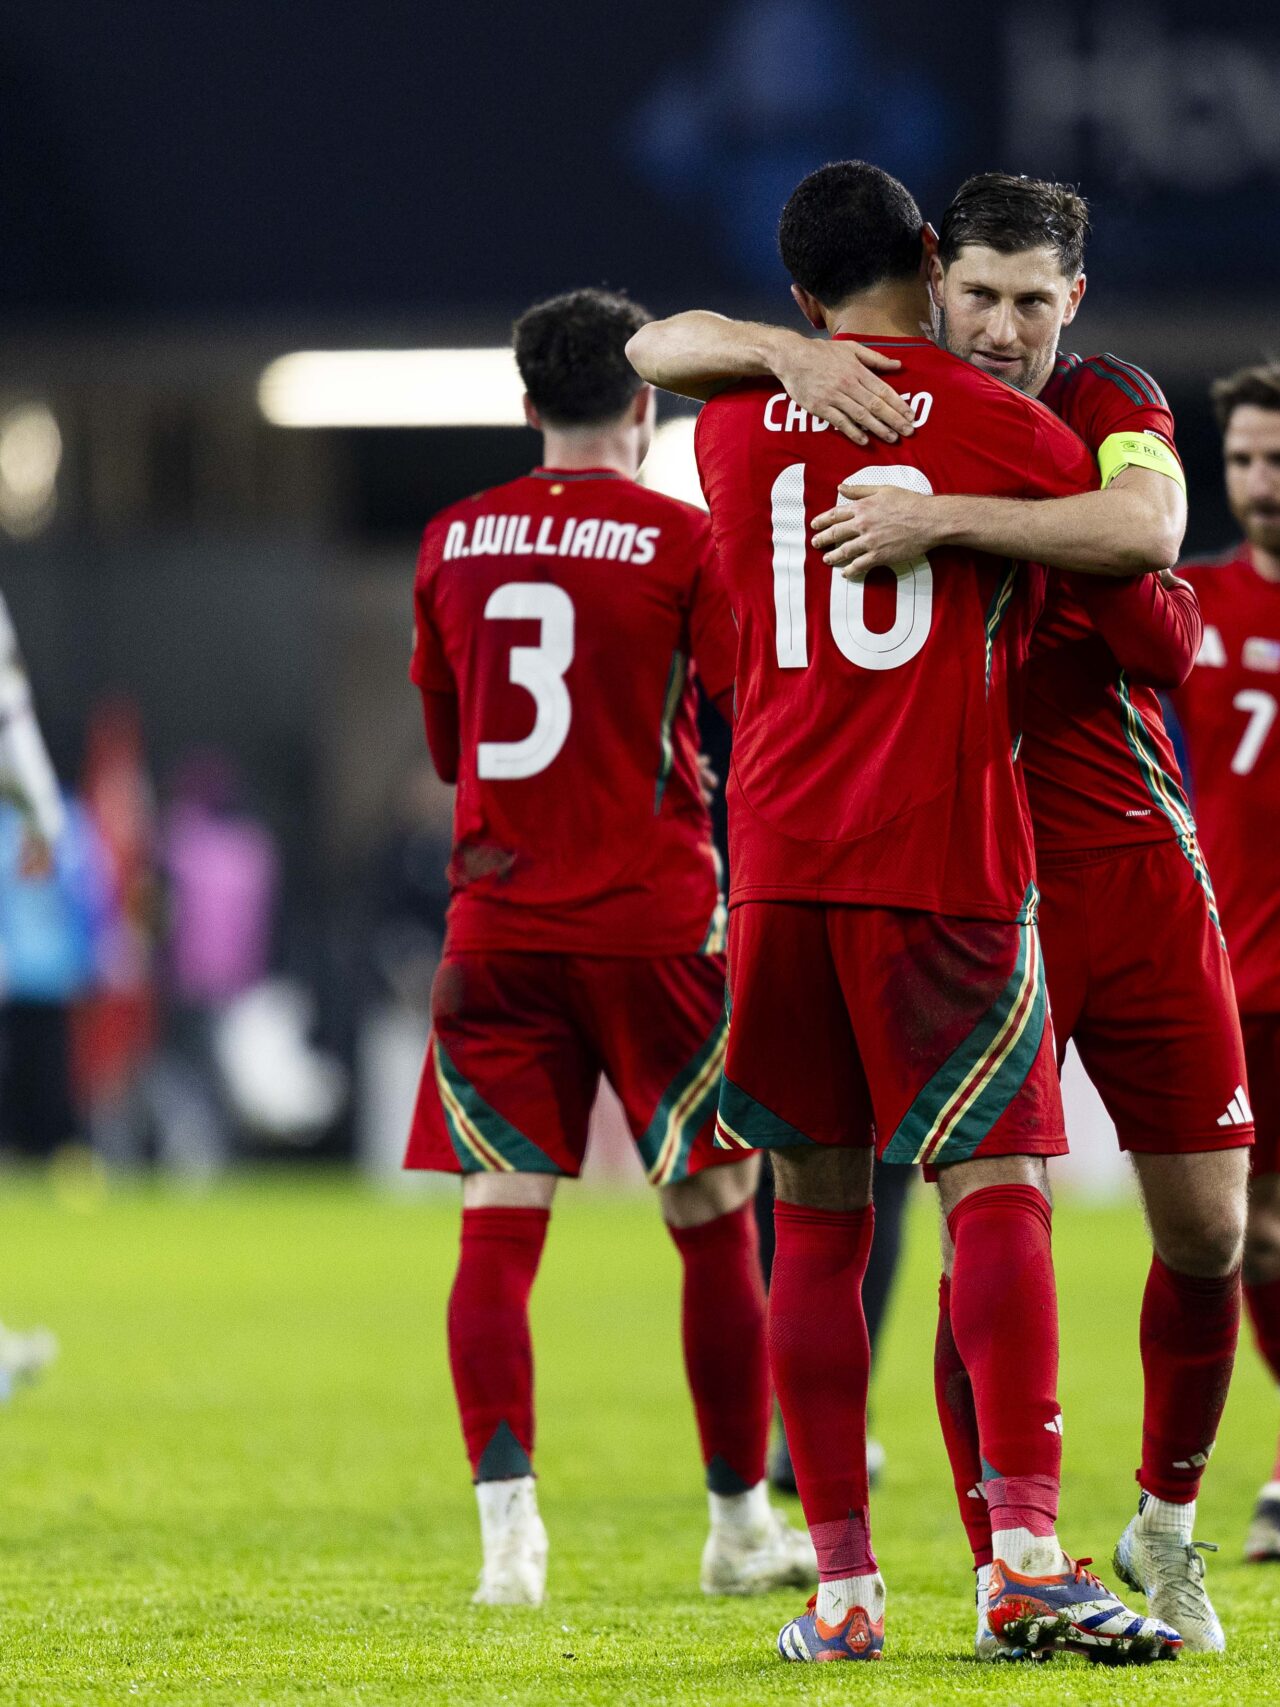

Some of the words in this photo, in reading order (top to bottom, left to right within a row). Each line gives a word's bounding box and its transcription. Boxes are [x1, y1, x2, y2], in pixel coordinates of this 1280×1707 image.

[443, 515, 660, 565] N.WILLIAMS
[477, 582, 575, 780] 3
[1231, 690, 1278, 775] 7
